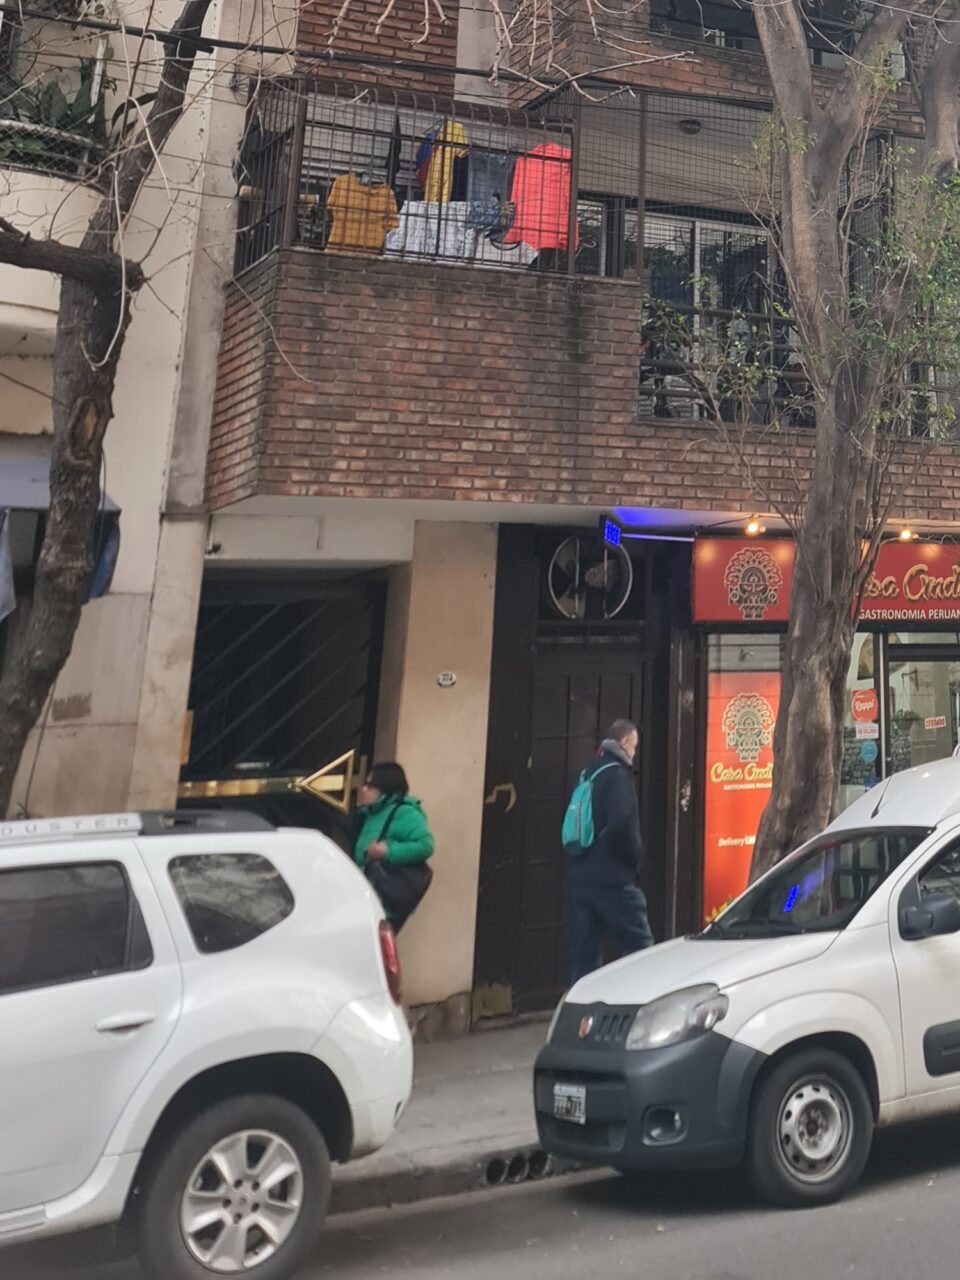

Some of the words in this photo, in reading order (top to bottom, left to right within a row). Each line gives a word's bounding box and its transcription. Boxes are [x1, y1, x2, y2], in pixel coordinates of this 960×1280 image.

[859, 609, 926, 620] GASTRONOMIA
[711, 762, 744, 782] Casa
[744, 762, 773, 781] And
[1, 817, 129, 836] DUSTER
